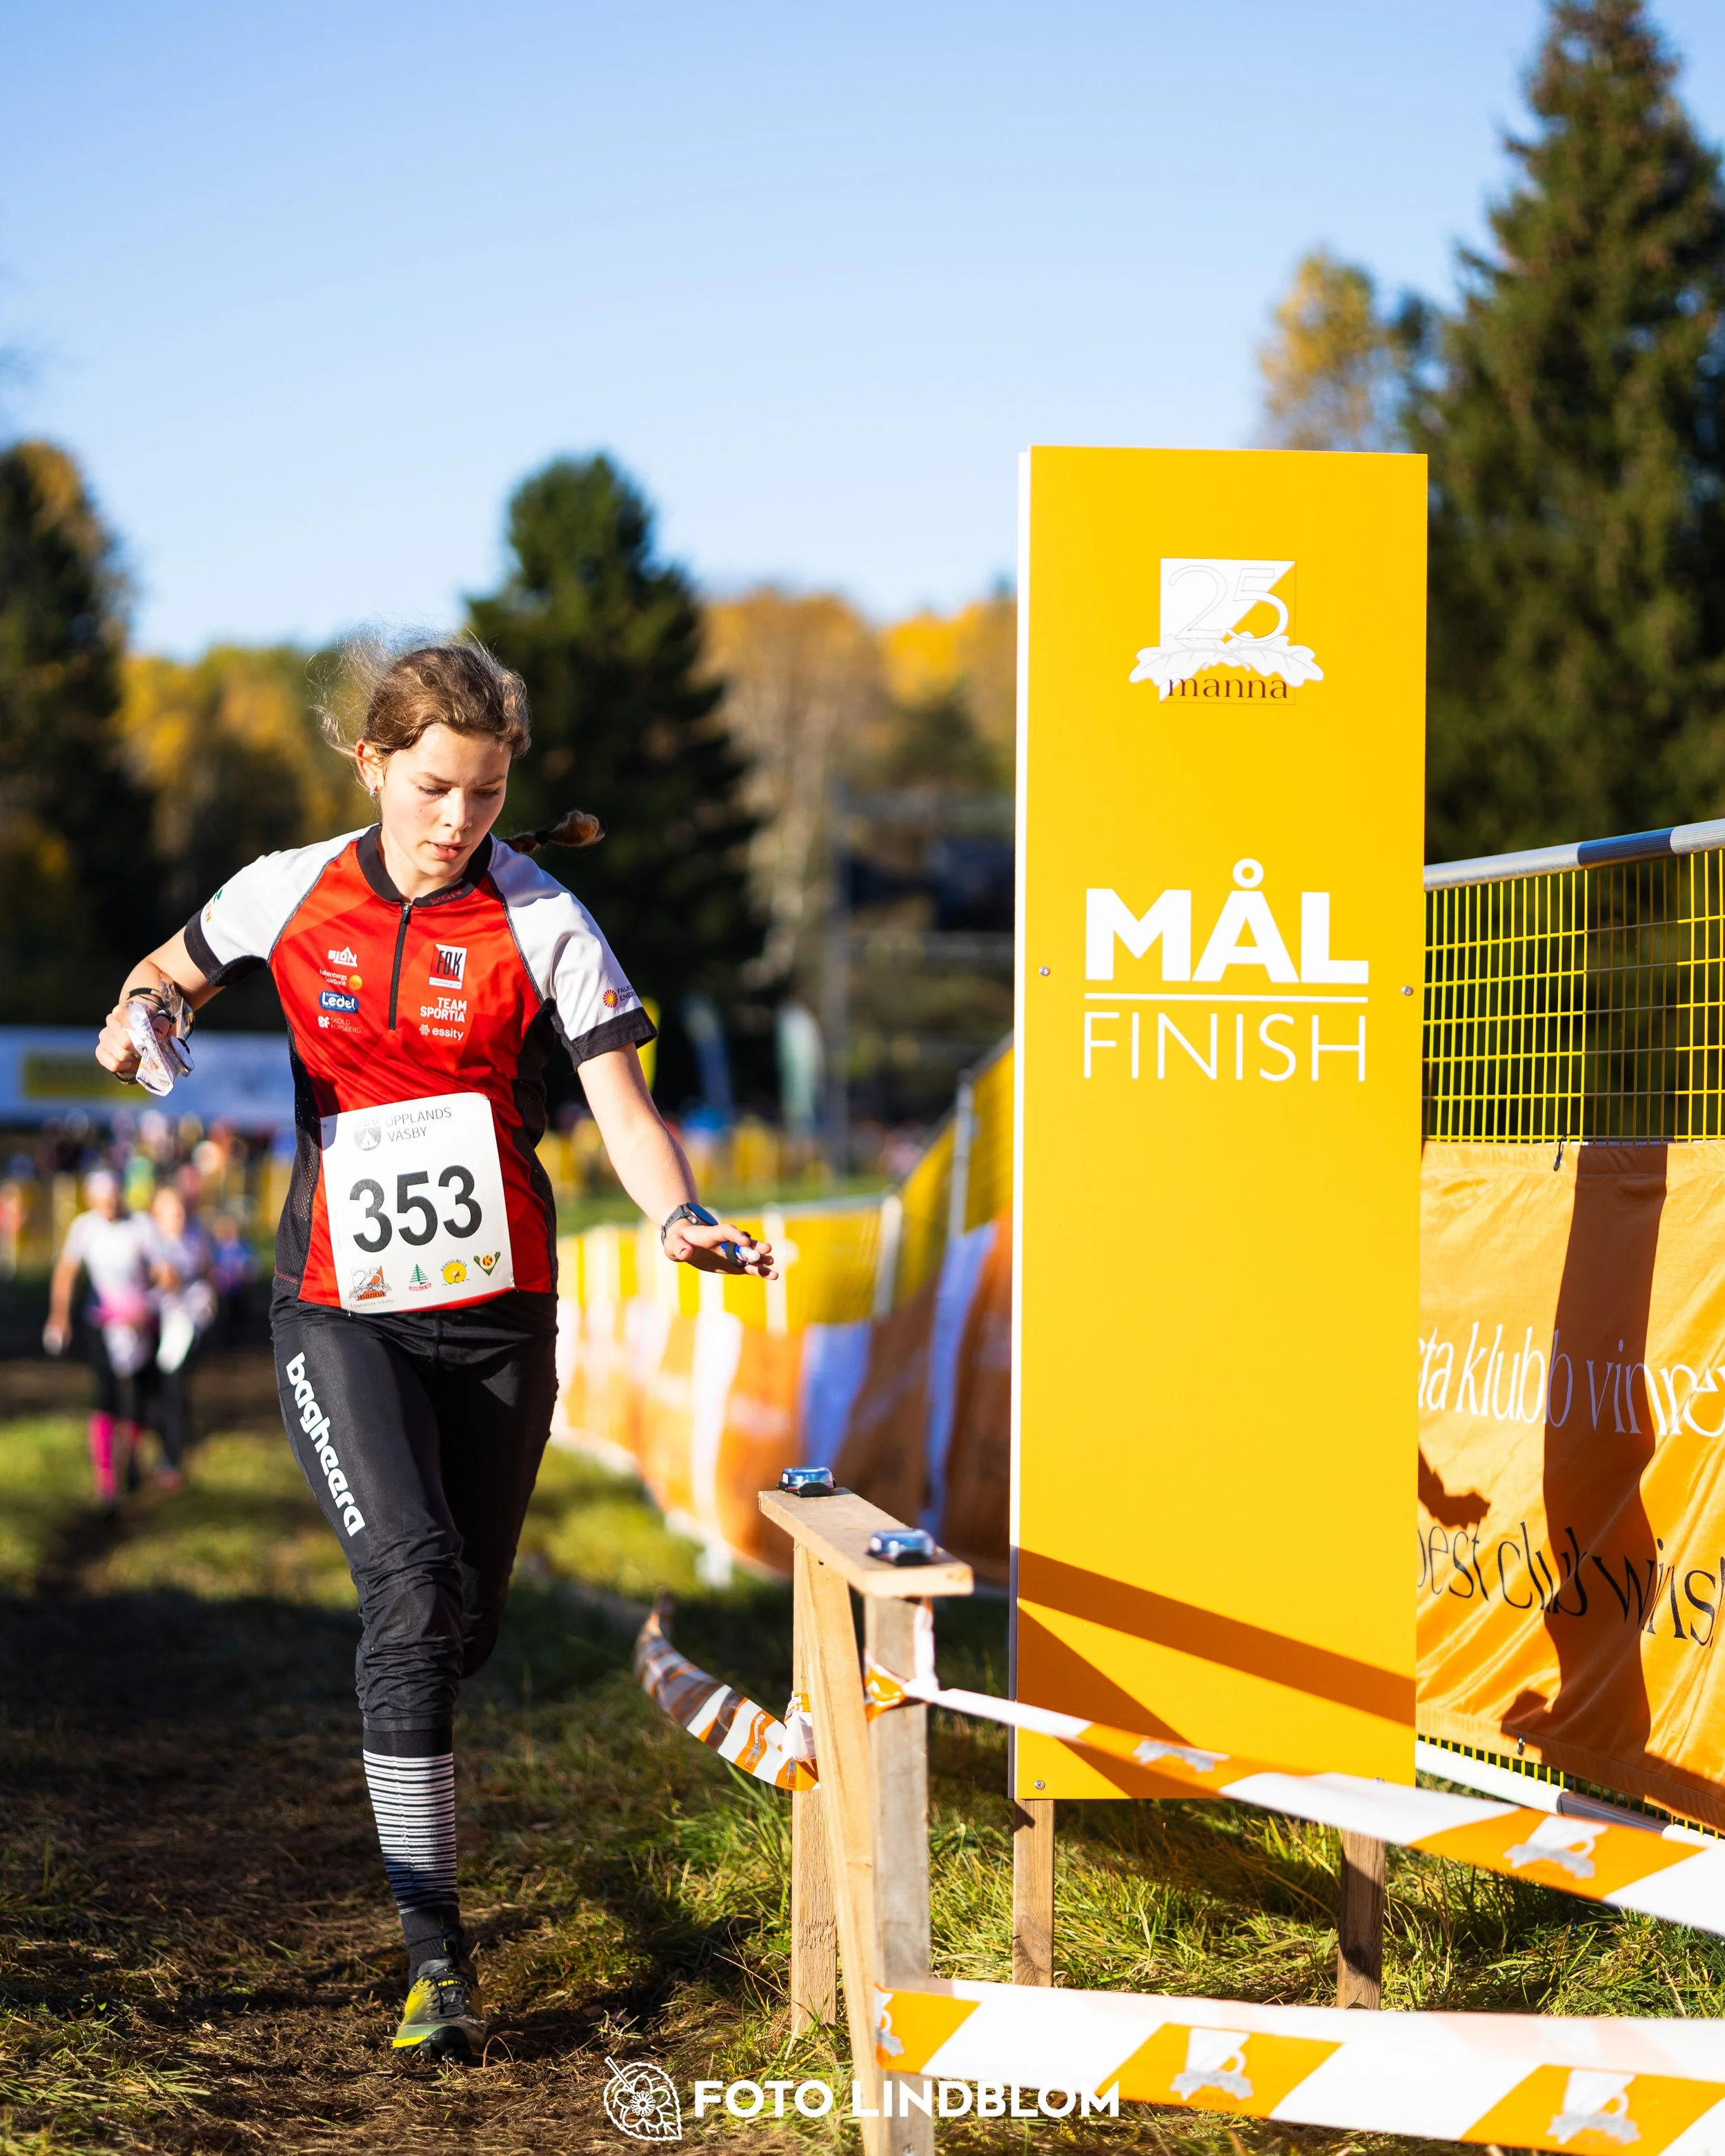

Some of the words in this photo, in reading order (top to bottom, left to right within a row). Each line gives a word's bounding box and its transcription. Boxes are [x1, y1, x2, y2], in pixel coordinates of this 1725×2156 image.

[1168, 565, 1289, 642] 25
[1167, 678, 1288, 699] manna
[1085, 858, 1369, 984] MÅL
[436, 950, 463, 976] FOK
[322, 991, 355, 1010] Ledel
[437, 996, 467, 1011] TEAM
[420, 1005, 465, 1022] SPORTIA
[331, 1023, 361, 1034] FORSBERG
[432, 1027, 464, 1041] essity
[1084, 1011, 1366, 1082] FINISH
[385, 1107, 451, 1127] UPPLANDS
[388, 1126, 426, 1142] VÄSBY
[350, 1165, 482, 1252] 353
[353, 1267, 382, 1286] 25
[357, 1291, 385, 1300] manna
[1455, 1321, 1573, 1427] klubb
[1587, 1339, 1725, 1437] vinne
[286, 1352, 366, 1536] bagheera
[1497, 1521, 1588, 1616] club
